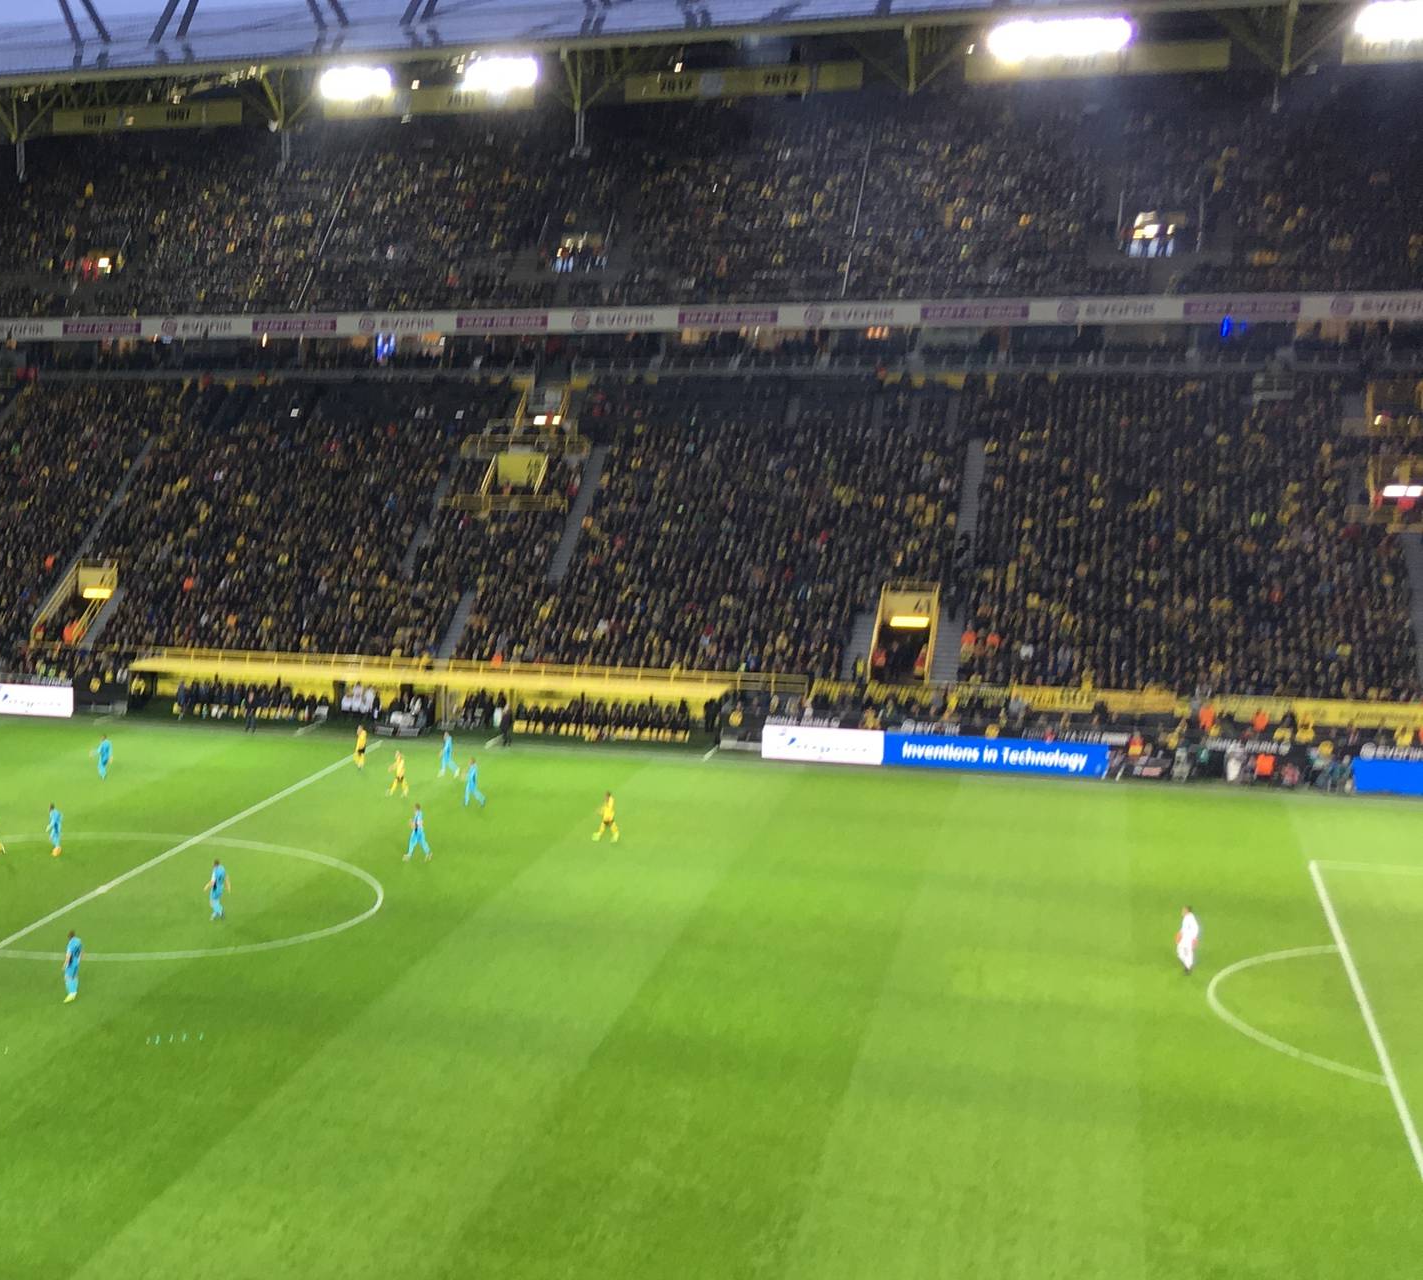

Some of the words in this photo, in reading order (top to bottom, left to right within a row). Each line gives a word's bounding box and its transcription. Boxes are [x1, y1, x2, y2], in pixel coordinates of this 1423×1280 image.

[902, 740, 979, 763] Inventions
[982, 744, 998, 764] in
[1002, 746, 1089, 773] Technology
